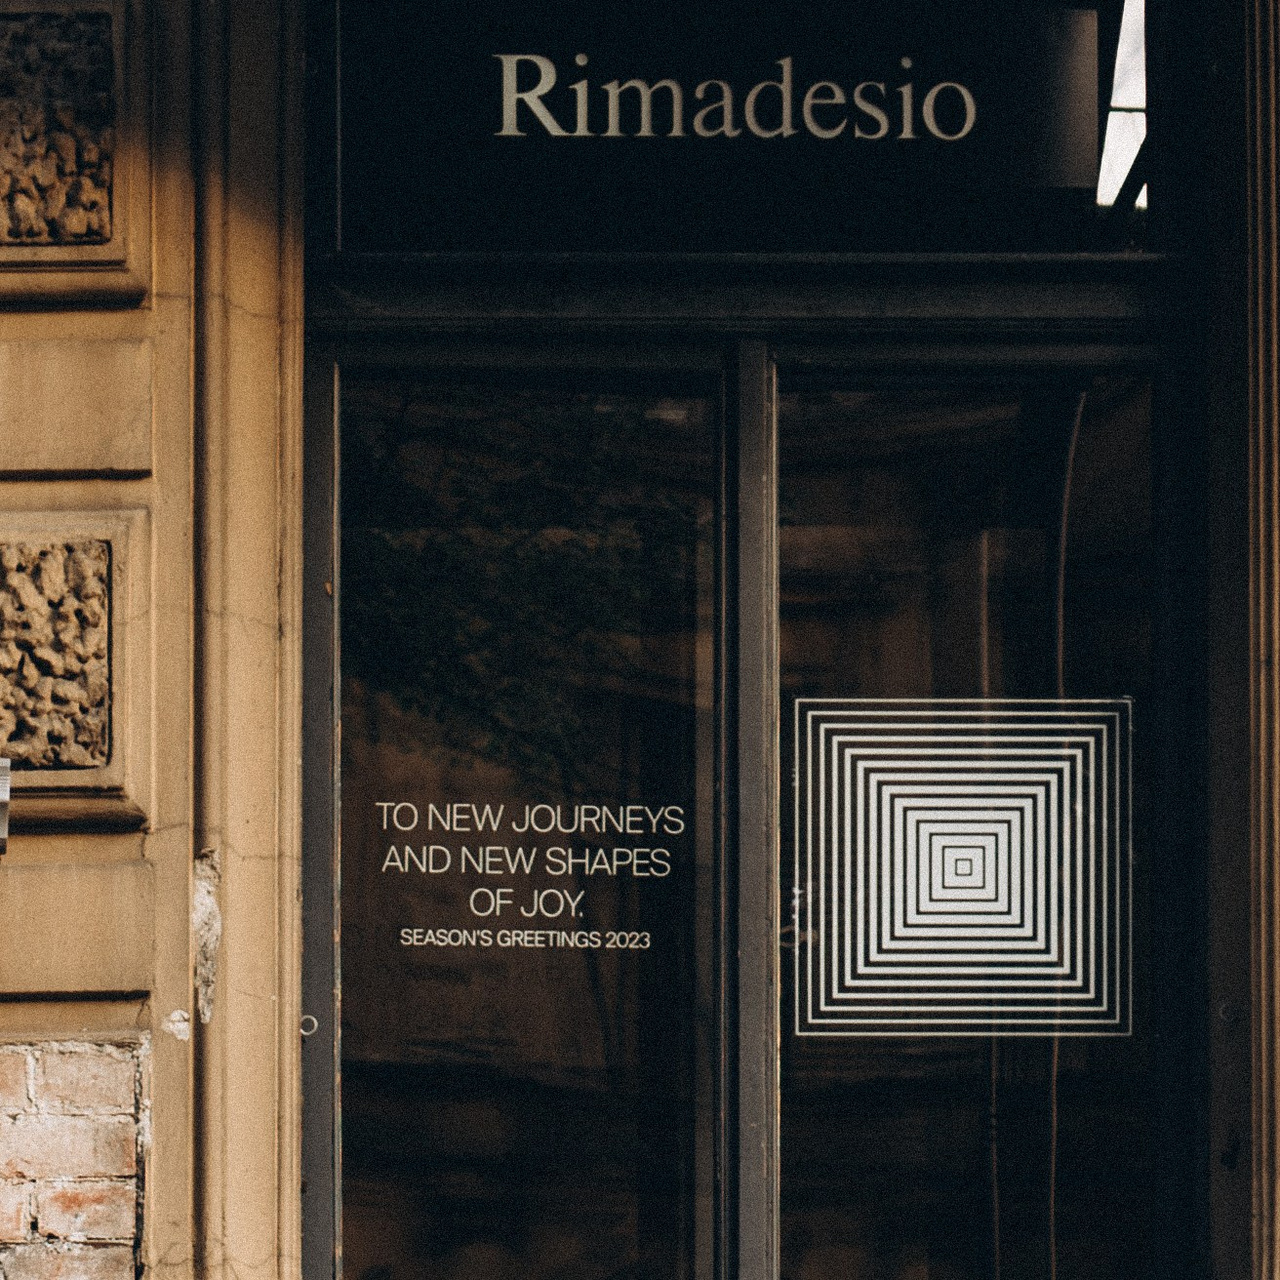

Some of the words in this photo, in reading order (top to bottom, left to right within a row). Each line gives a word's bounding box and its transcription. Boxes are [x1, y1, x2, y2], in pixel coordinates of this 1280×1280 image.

[493, 53, 977, 142] Rimadesio
[375, 801, 419, 831] TO
[428, 803, 505, 833] NEW
[512, 803, 685, 835] JOURNEYS
[381, 844, 452, 873] AND
[461, 845, 537, 875] NEW
[545, 846, 671, 877] SHAPES
[469, 887, 514, 917] OF
[520, 888, 586, 918] JOY.
[400, 928, 493, 947] SEASON'S
[497, 929, 602, 949] GREETINGS
[605, 931, 651, 950] 2023
